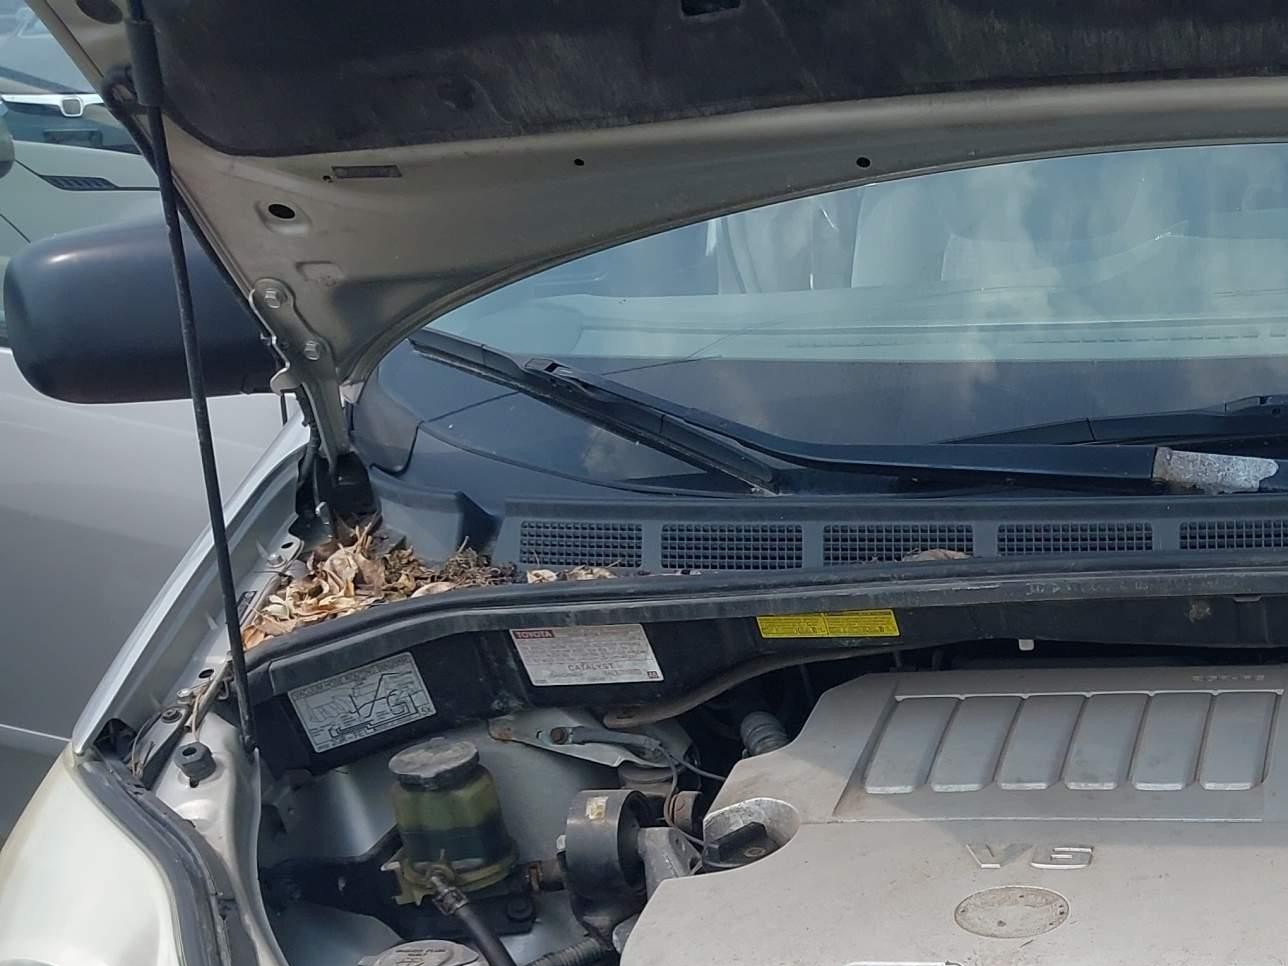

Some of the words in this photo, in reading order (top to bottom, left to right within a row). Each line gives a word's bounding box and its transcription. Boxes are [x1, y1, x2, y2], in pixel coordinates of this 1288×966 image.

[515, 631, 553, 639] TOYOTA
[568, 662, 615, 671] CATALYST
[966, 843, 1095, 870] V6
